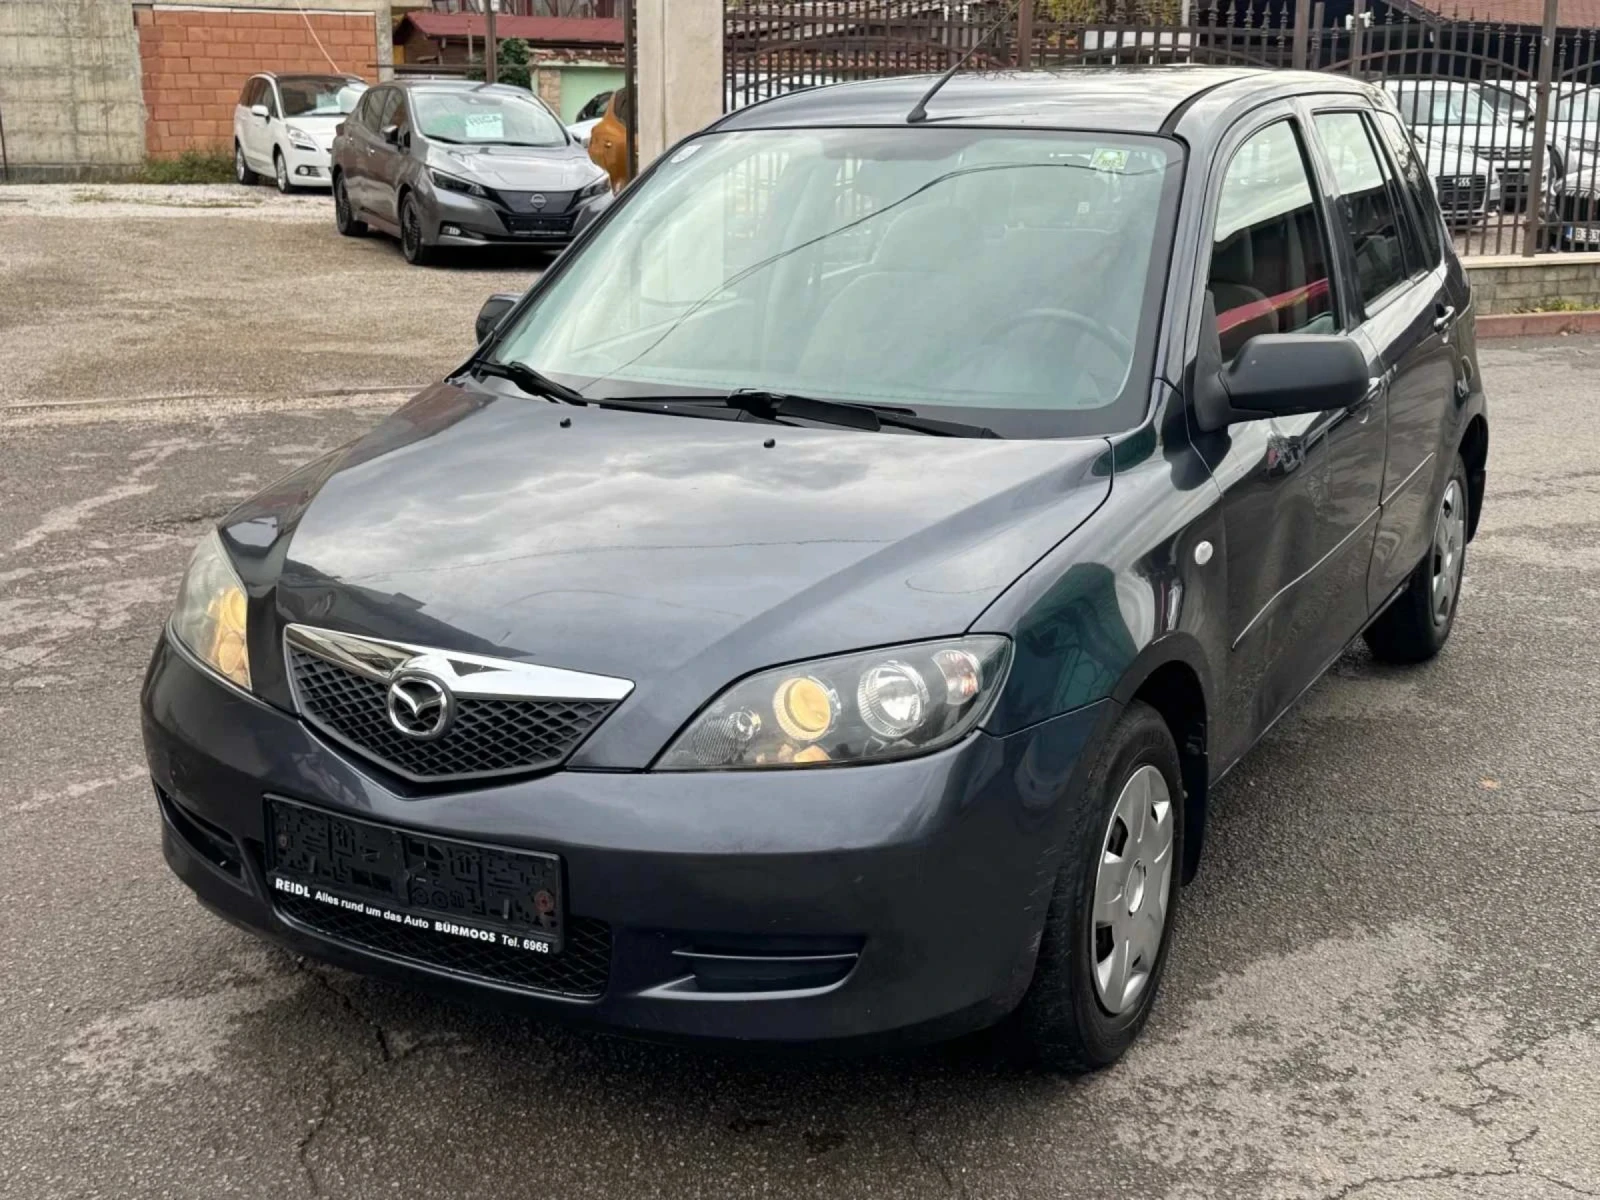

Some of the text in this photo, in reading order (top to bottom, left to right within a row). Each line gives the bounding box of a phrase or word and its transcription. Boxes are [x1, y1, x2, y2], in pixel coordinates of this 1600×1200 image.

[275, 878, 549, 954] REIDL Alles rund um das Auto BÜRMOOS Tel. 6965
